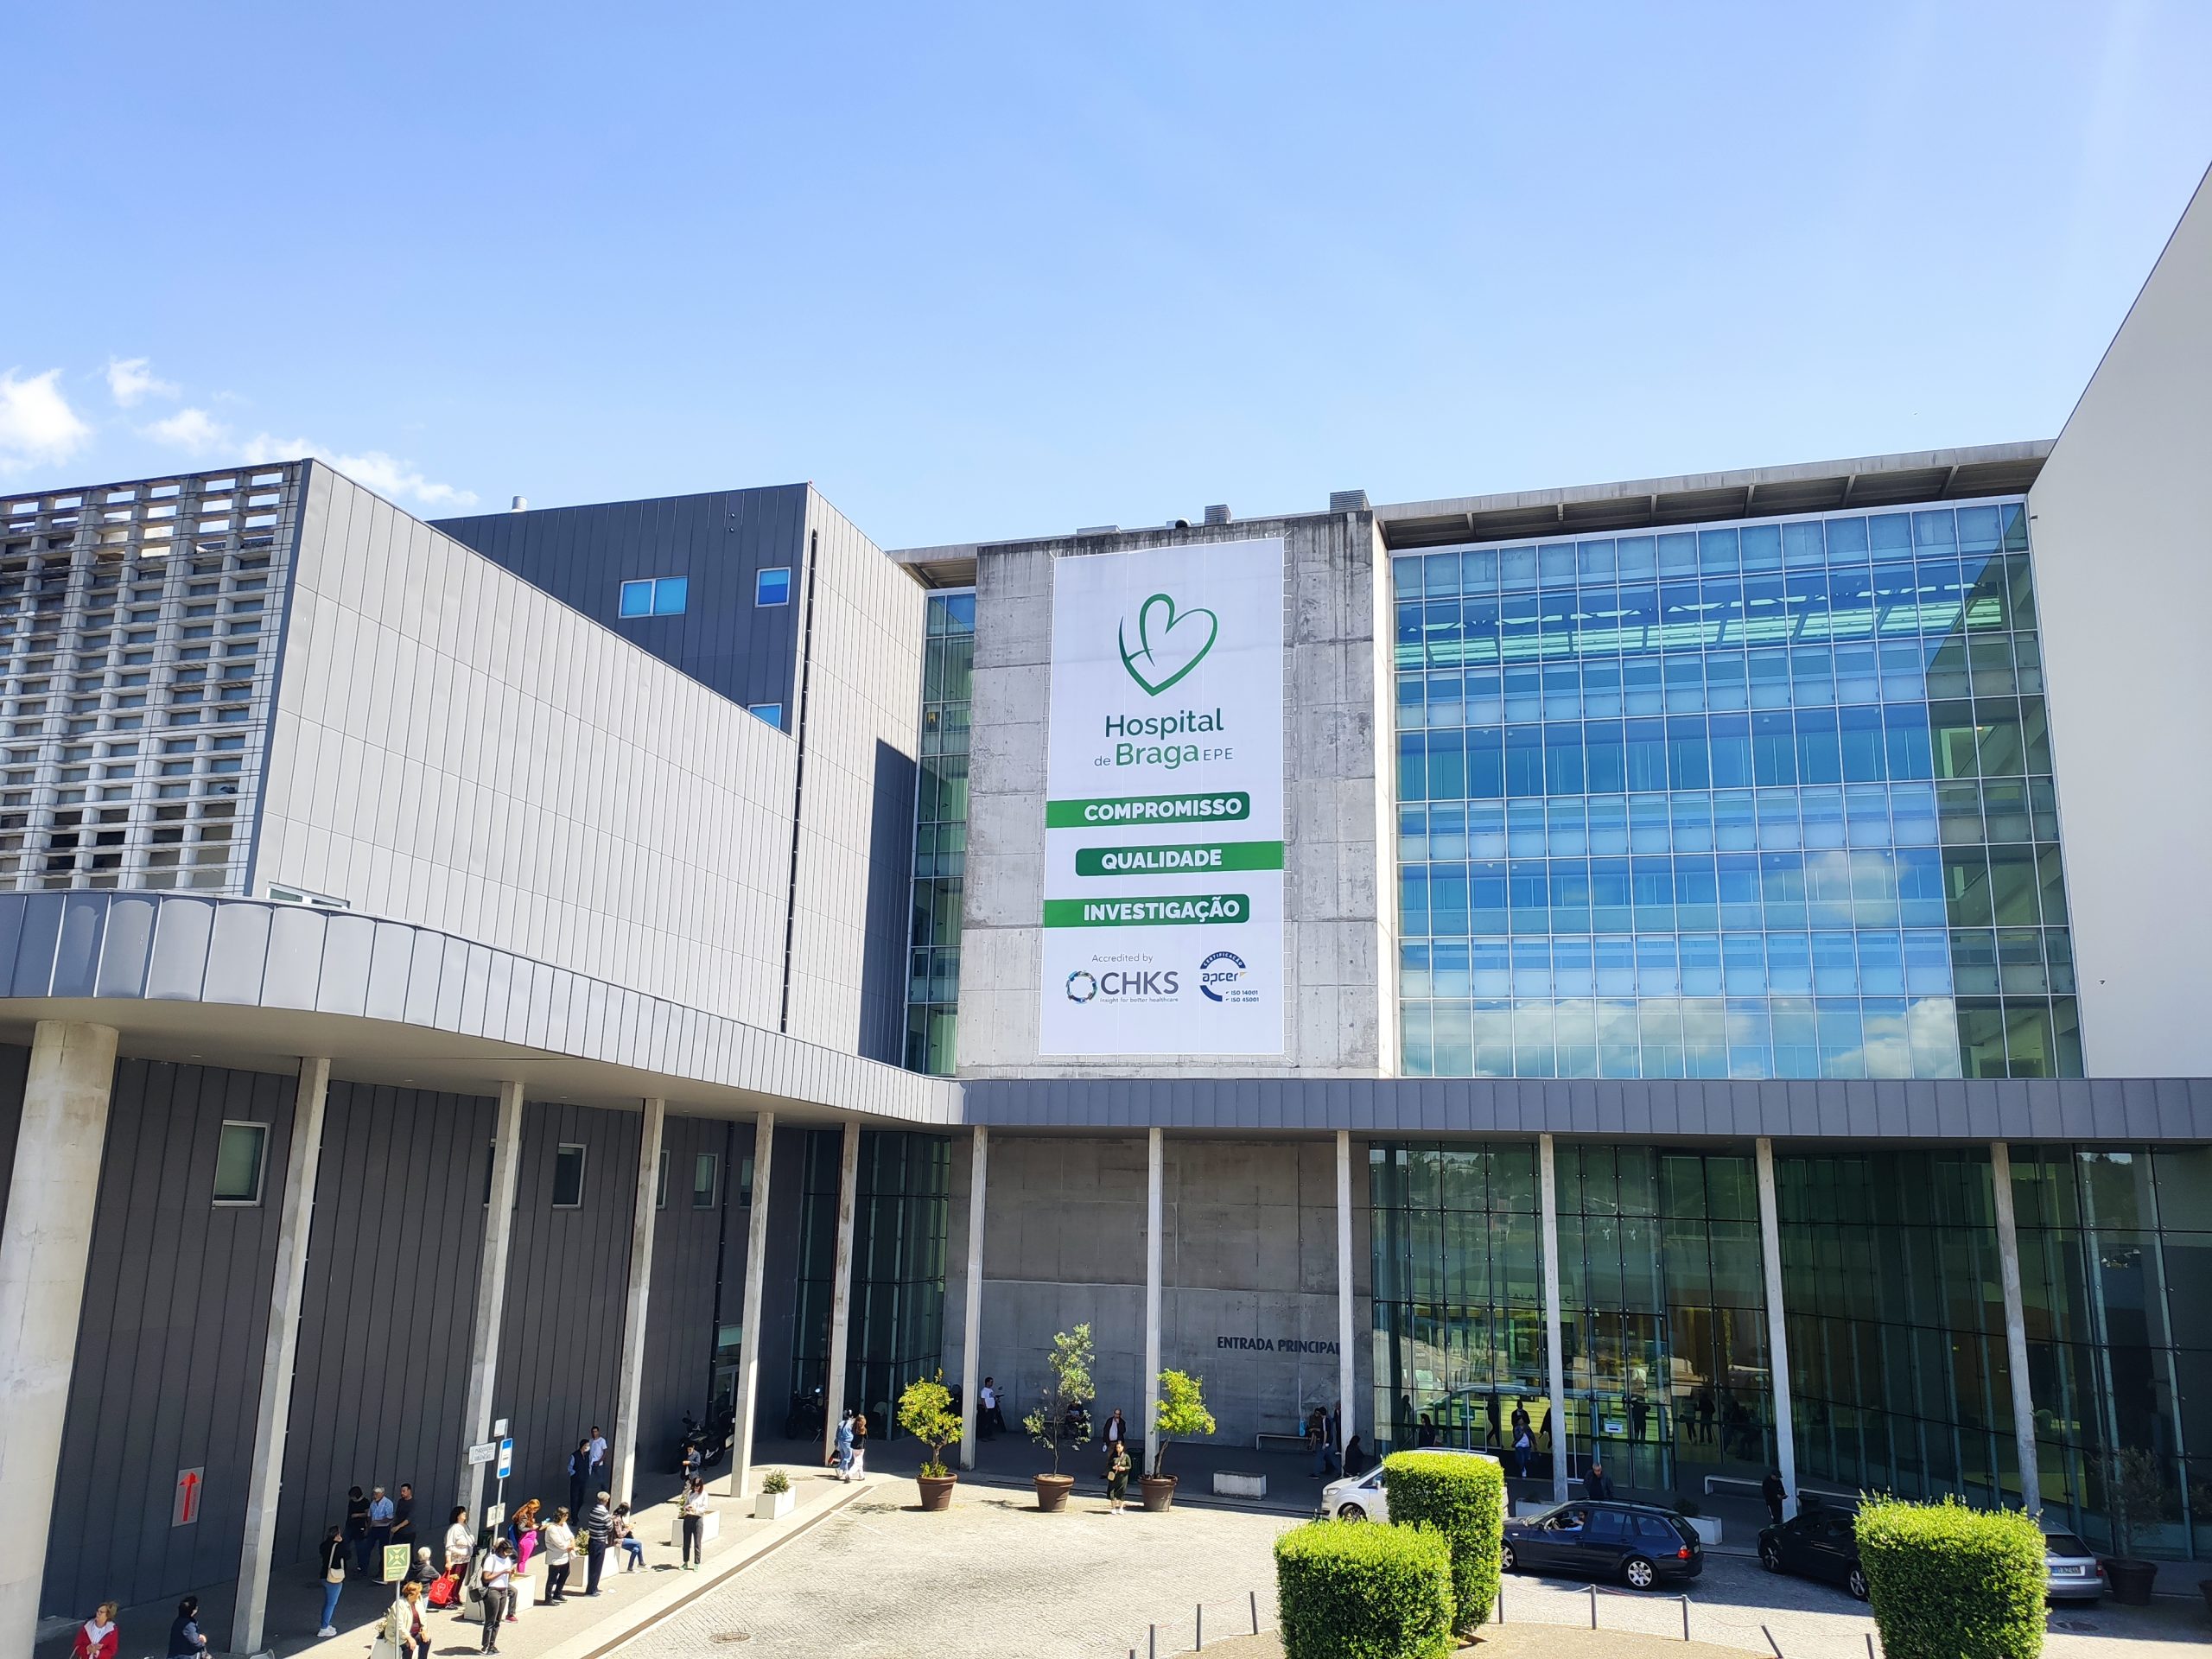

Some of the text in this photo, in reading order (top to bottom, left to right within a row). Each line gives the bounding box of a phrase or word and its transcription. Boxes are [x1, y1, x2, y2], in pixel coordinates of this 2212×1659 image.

[1105, 707, 1224, 740] Hospital
[1094, 742, 1234, 769] de Braga EPE
[1084, 798, 1243, 821] COMPROMISSO
[1101, 849, 1223, 870] QUALIDADE
[1084, 896, 1240, 923] INVESTIGAÇÃO
[1091, 952, 1154, 963] Accredited by
[1100, 970, 1179, 995] CHKS
[1202, 972, 1239, 986] apcer
[1217, 1336, 1274, 1351] ENTRADA
